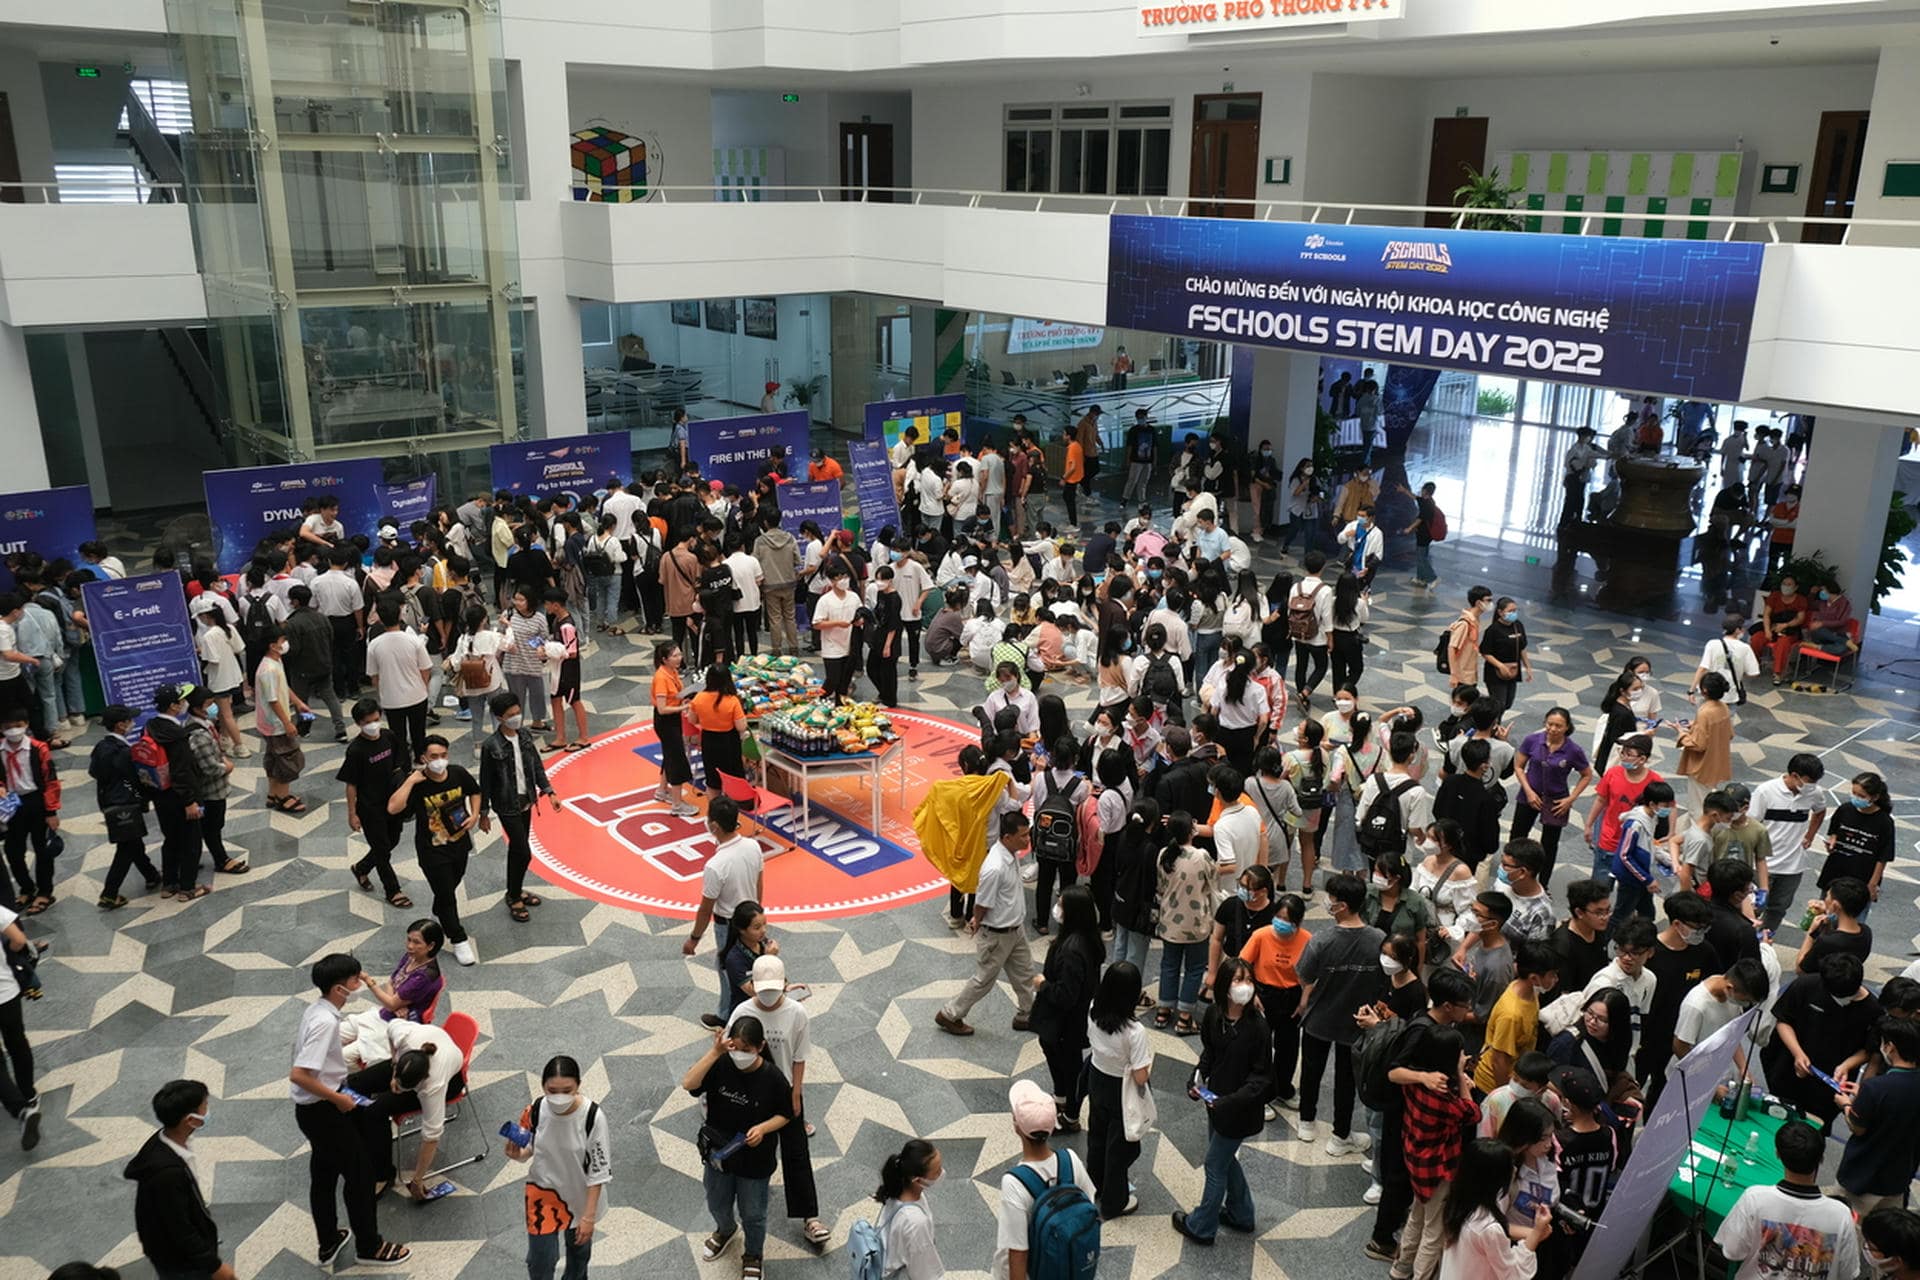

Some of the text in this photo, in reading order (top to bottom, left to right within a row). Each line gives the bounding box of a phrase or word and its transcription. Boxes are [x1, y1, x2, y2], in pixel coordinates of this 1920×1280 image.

[1381, 240, 1452, 266] FSCHOOLS
[1186, 276, 1610, 334] CHÀO MỪNG ĐẾN VỚI NGÀY HỘI KHOA HỌC CÔNG NGHỆ
[1188, 304, 1604, 376] FSCHOOLS STEM DAY 2022
[709, 452, 733, 465] FIRE
[734, 451, 745, 461] IN
[746, 449, 766, 459] THE
[573, 478, 593, 486] space
[263, 507, 304, 522] DYNA
[782, 510, 794, 518] Fly
[804, 507, 816, 515] the
[817, 506, 839, 515] space
[0, 540, 27, 555] UIT
[132, 604, 161, 617] Fruit
